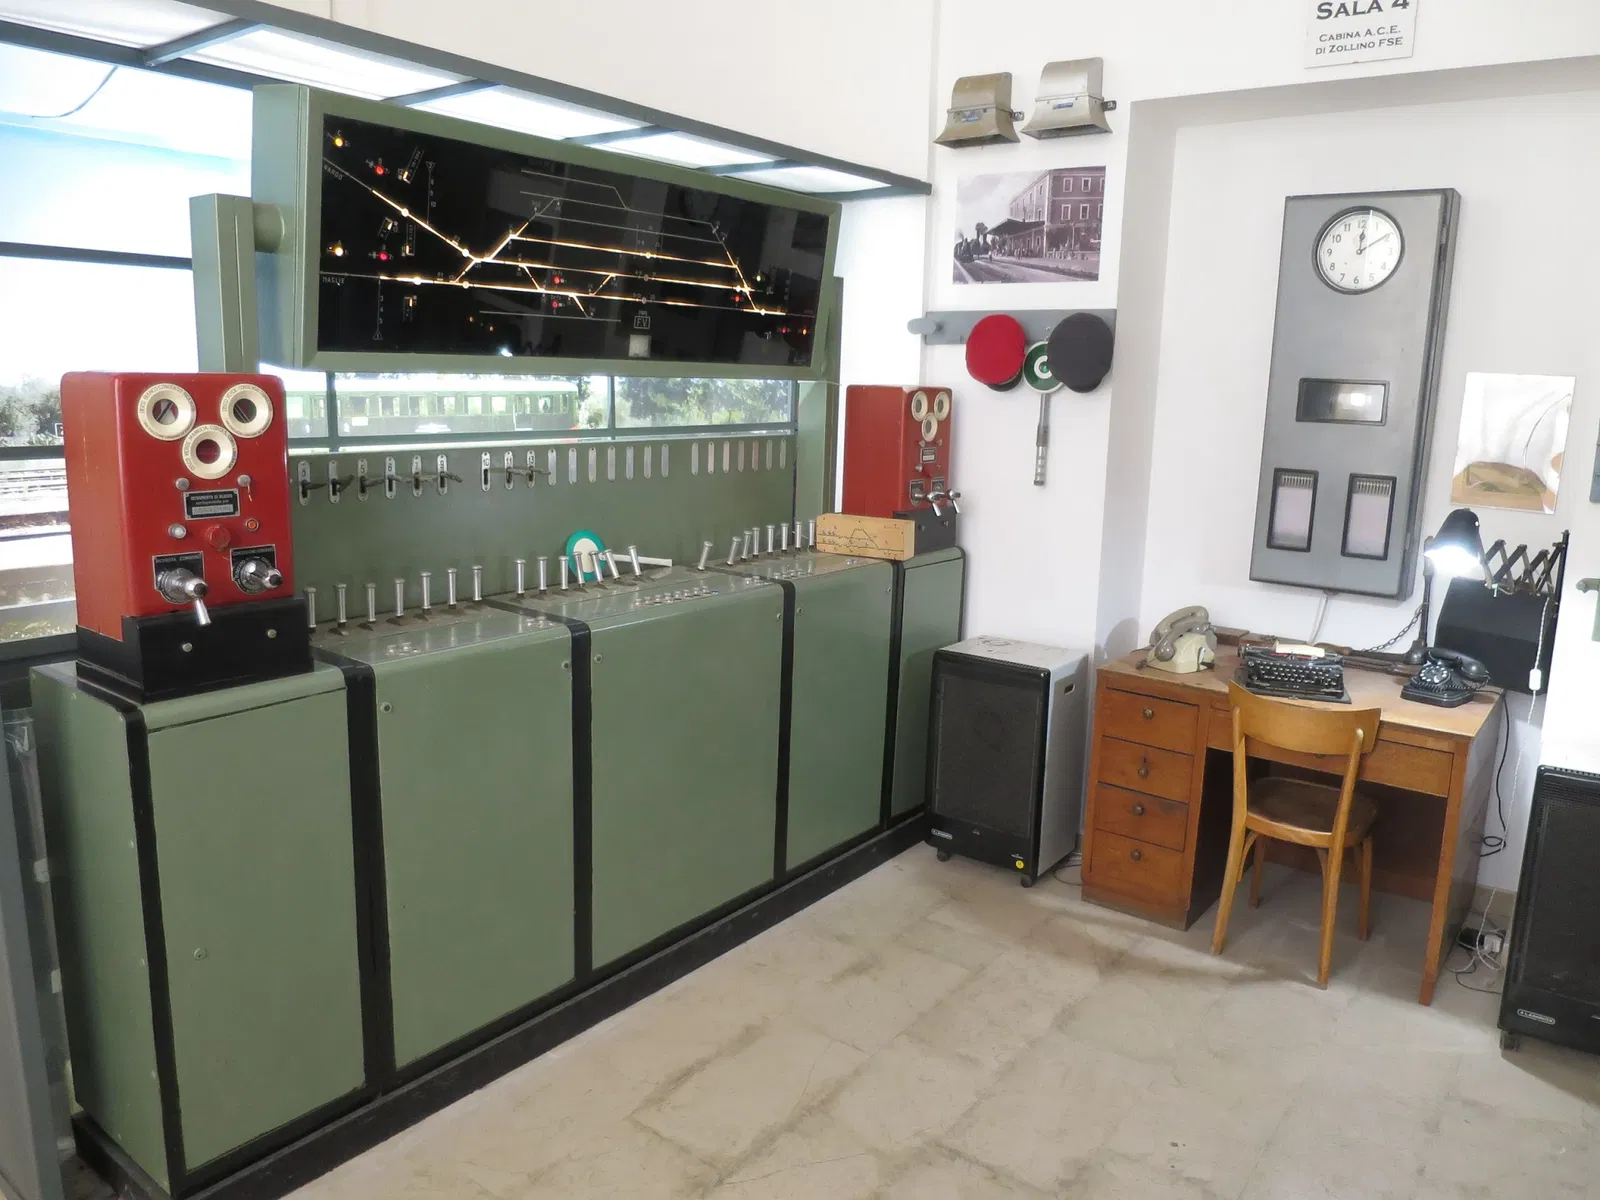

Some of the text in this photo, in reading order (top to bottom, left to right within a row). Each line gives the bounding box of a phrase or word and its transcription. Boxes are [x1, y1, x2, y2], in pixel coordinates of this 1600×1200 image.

[1316, 0, 1410, 20] SALA 4
[1319, 25, 1401, 42] CABINA A.C.E.
[1315, 36, 1404, 55] DI ZOLLINO FSE
[1344, 223, 1351, 232] 11
[1358, 220, 1367, 229] 12
[1332, 234, 1341, 243] 10
[1327, 248, 1332, 257] 9
[1329, 262, 1335, 271] 8
[1381, 262, 1386, 270] 4
[1340, 273, 1345, 282] 7
[1353, 275, 1359, 284] 6
[1369, 273, 1374, 281] 5
[482, 457, 489, 467] 10
